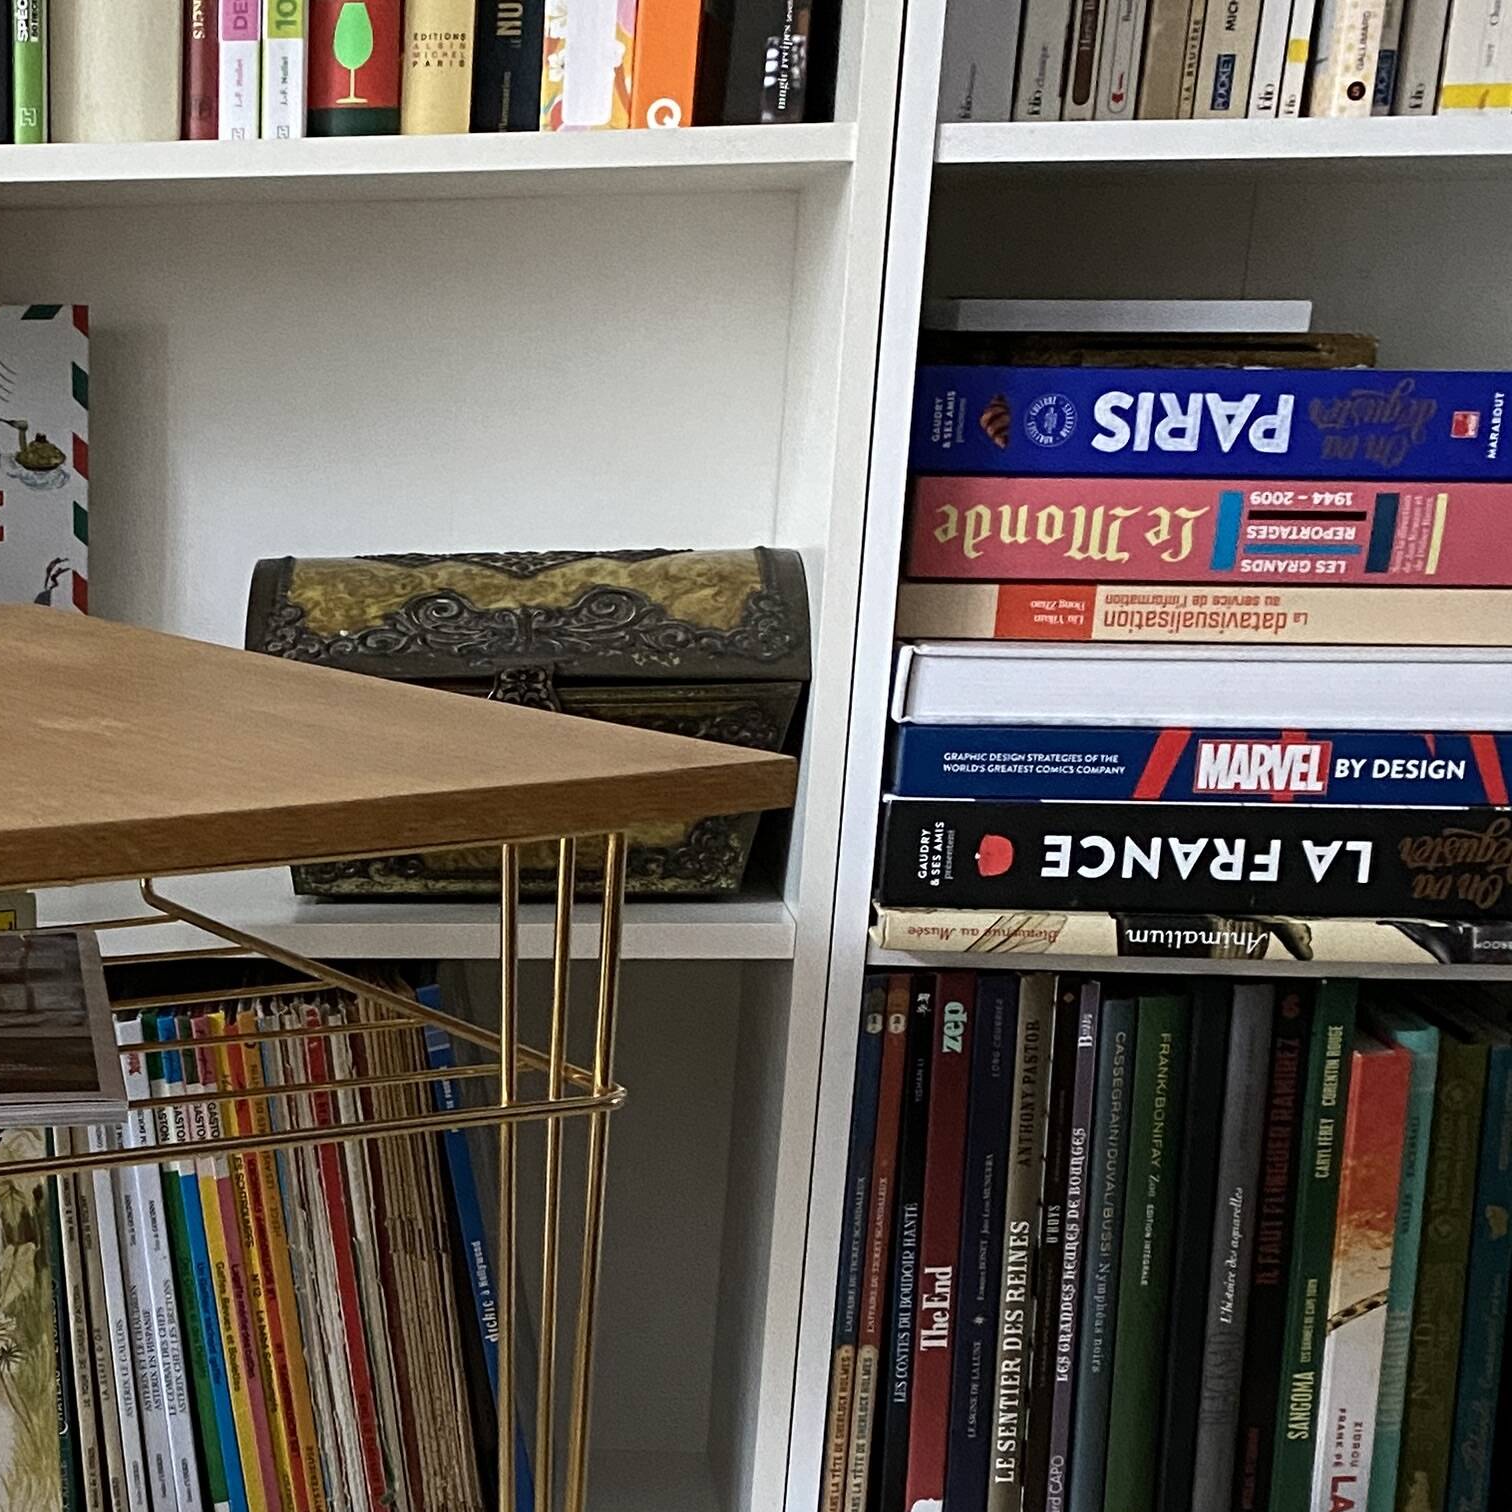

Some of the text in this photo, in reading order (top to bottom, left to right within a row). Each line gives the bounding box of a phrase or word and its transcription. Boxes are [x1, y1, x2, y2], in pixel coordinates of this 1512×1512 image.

[1091, 390, 1295, 453] PARIS
[1487, 391, 1506, 460] MARABOUT
[1249, 491, 1353, 506] 1944 2009
[933, 503, 1211, 565] Le Monde
[1246, 525, 1356, 540] REPORTAGES
[1240, 559, 1346, 573] LES GRANDS
[1103, 610, 1287, 635] datavisualisation
[943, 752, 1119, 763] GRAPHIC DESIGN STRATEGIES OF THE
[943, 763, 1126, 775] WORLD'S GREATEST COMICS COMPANY
[1196, 741, 1466, 793] MARVEL BY DESIGN
[917, 828, 932, 879] GAUDRY
[934, 821, 945, 852] AMIS
[931, 854, 941, 875] SES
[1040, 835, 1373, 885] LA FRANCE
[1125, 928, 1271, 955] Animalium
[1016, 1019, 1041, 1168] ANTHONY PASTOR
[156, 1106, 170, 1142] ASTON
[207, 1101, 220, 1138] GASTO
[920, 1265, 953, 1352] The End
[995, 1220, 1030, 1484] LE SENTIER DES REINES
[1287, 1371, 1315, 1440] SANGOMA
[1047, 1455, 1065, 1496] CAPO
